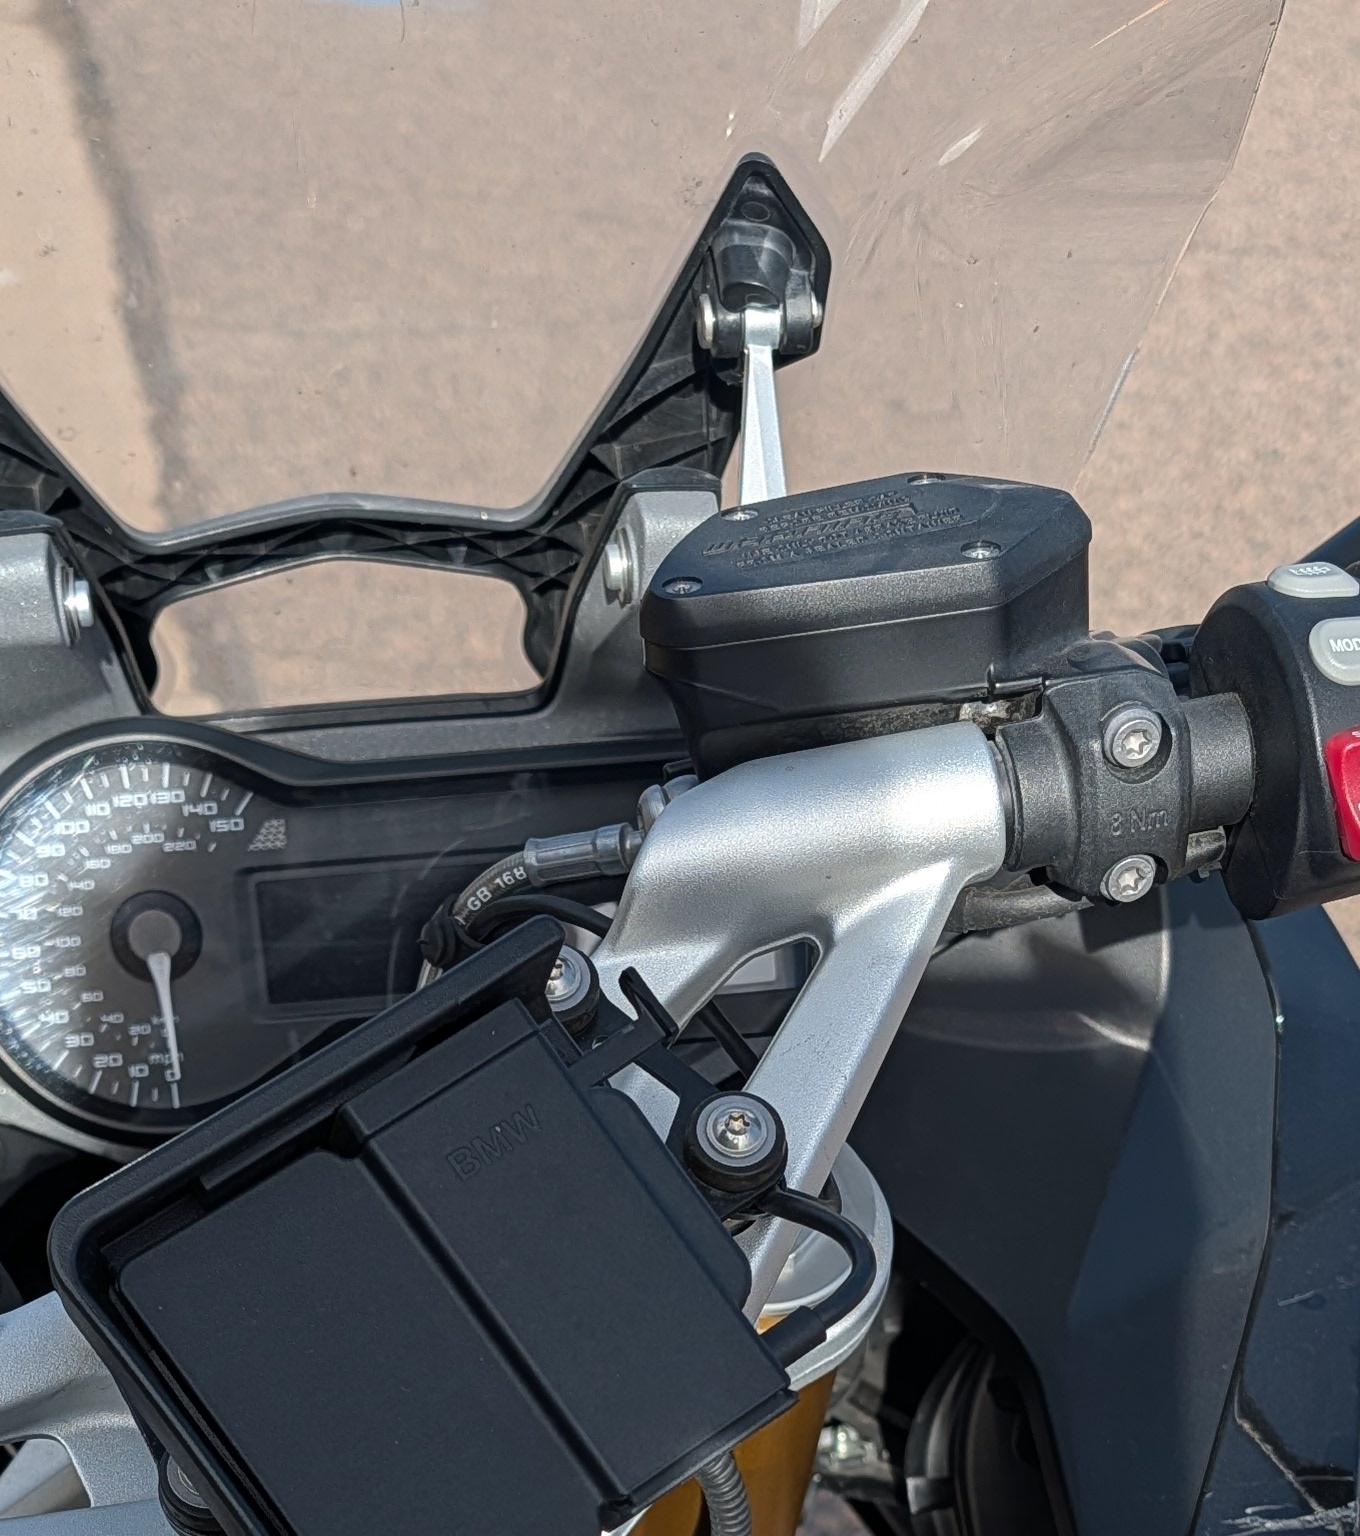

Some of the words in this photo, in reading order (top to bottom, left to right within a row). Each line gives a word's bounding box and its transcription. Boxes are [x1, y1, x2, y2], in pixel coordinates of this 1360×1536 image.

[111, 793, 149, 808] 120
[149, 789, 186, 804] 130
[84, 802, 111, 817] 110
[181, 801, 218, 817] 140
[53, 819, 90, 835] 100
[208, 817, 245, 833] 150
[130, 832, 165, 845] 200
[162, 840, 197, 853] 220
[467, 887, 492, 911] GB
[64, 1032, 95, 1048] 30
[92, 1053, 124, 1069] 20
[127, 1063, 150, 1079] 10
[445, 1103, 542, 1182] BMW
